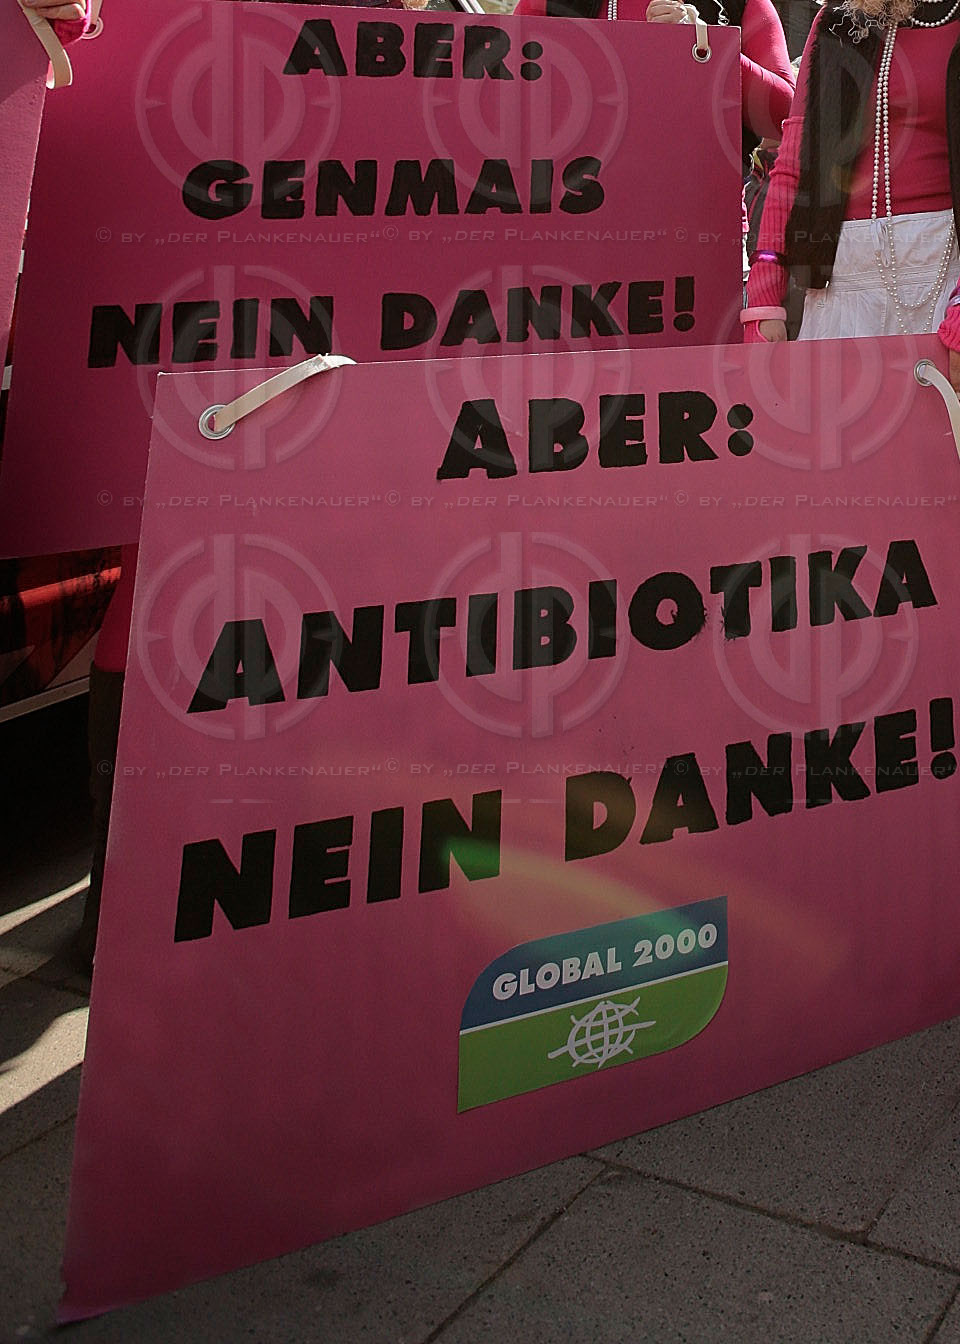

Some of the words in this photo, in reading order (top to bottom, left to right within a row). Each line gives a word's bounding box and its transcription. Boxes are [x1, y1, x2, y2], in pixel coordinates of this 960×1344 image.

[283, 19, 543, 80] ABER:
[182, 156, 605, 220] GENMAIS
[88, 296, 334, 369] NEIN
[380, 276, 696, 351] DANKE!
[436, 391, 754, 481] ABER:
[187, 540, 938, 713] ANTIBIOTIKA
[174, 790, 504, 943] NEIN
[564, 698, 957, 862] DANKE!
[492, 947, 622, 1001] GLOBAL
[632, 923, 718, 968] 2000
